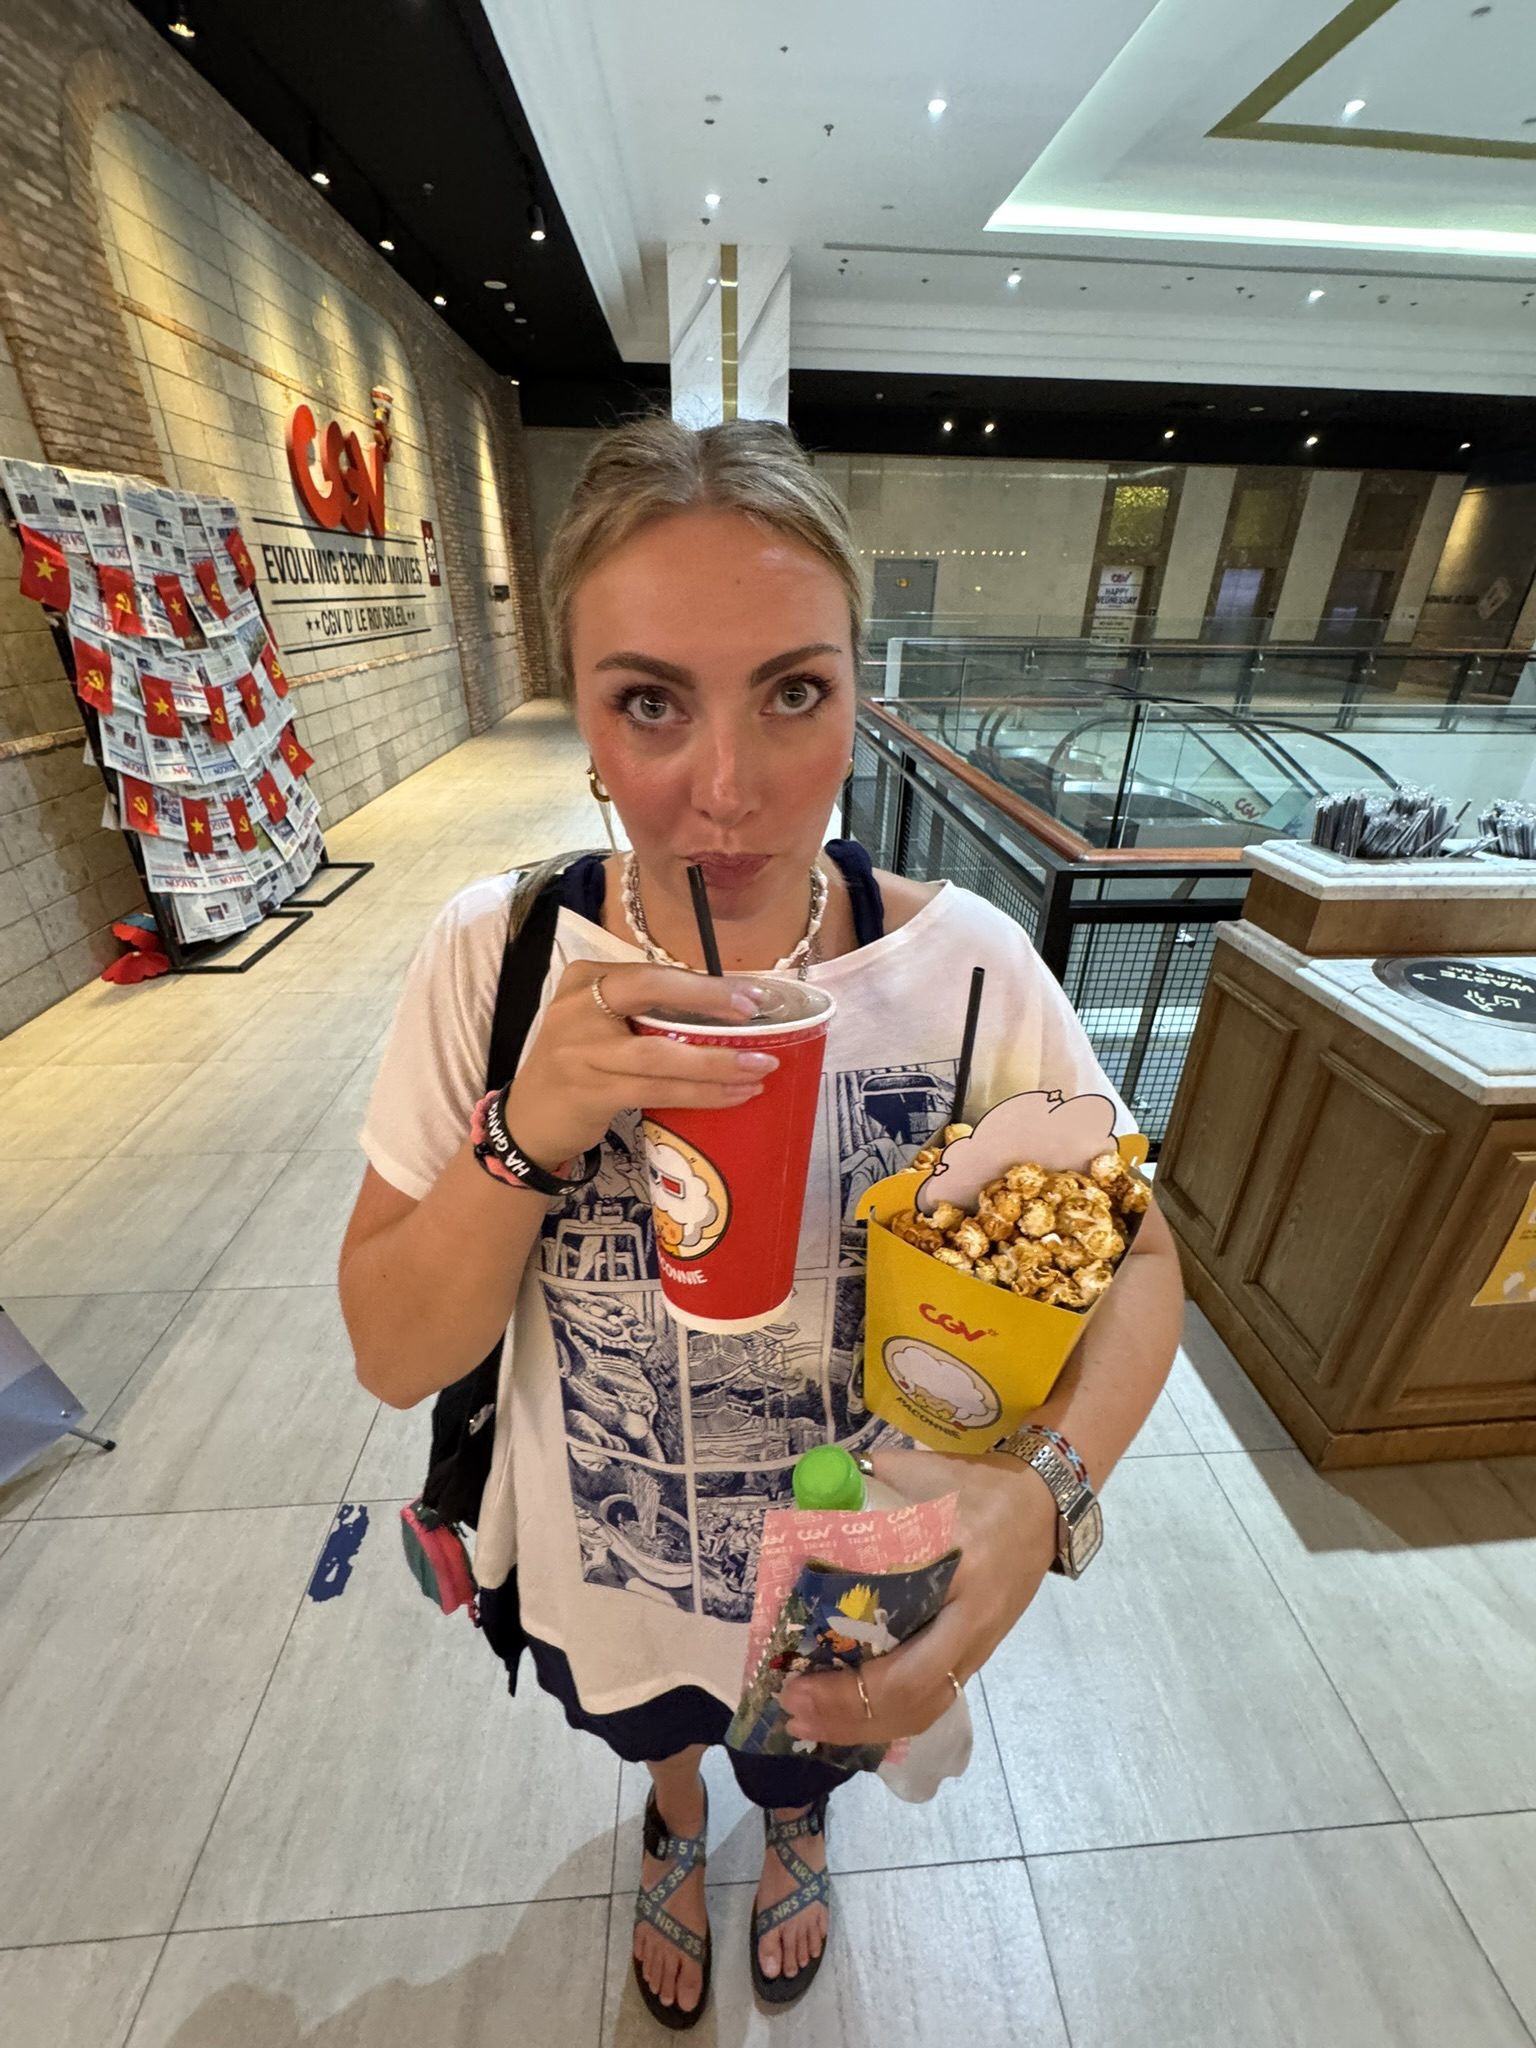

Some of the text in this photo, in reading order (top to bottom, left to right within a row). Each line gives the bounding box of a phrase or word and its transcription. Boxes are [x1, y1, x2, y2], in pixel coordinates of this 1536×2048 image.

[286, 404, 385, 539] CGV
[261, 544, 423, 585] EVOLVING BEYOND MOVIES
[1105, 587, 1129, 596] HAPPY
[321, 610, 342, 637] CGV
[355, 607, 366, 631] LE
[368, 606, 382, 629] ROI
[382, 606, 408, 629] SOLEIL
[1235, 798, 1262, 820] CGV
[1440, 969, 1535, 994] WASTE
[488, 1101, 530, 1177] HA GIANG
[657, 1257, 708, 1285] CONNIE
[919, 1303, 986, 1342] CGV
[887, 1504, 918, 1524] CGV
[797, 1523, 833, 1541] CGV
[841, 1520, 874, 1535] CGV
[781, 1823, 798, 1838] 35
[667, 1866, 686, 1887] 35
[771, 1881, 820, 1918] NRS 35
[654, 1911, 682, 1939] NRS
